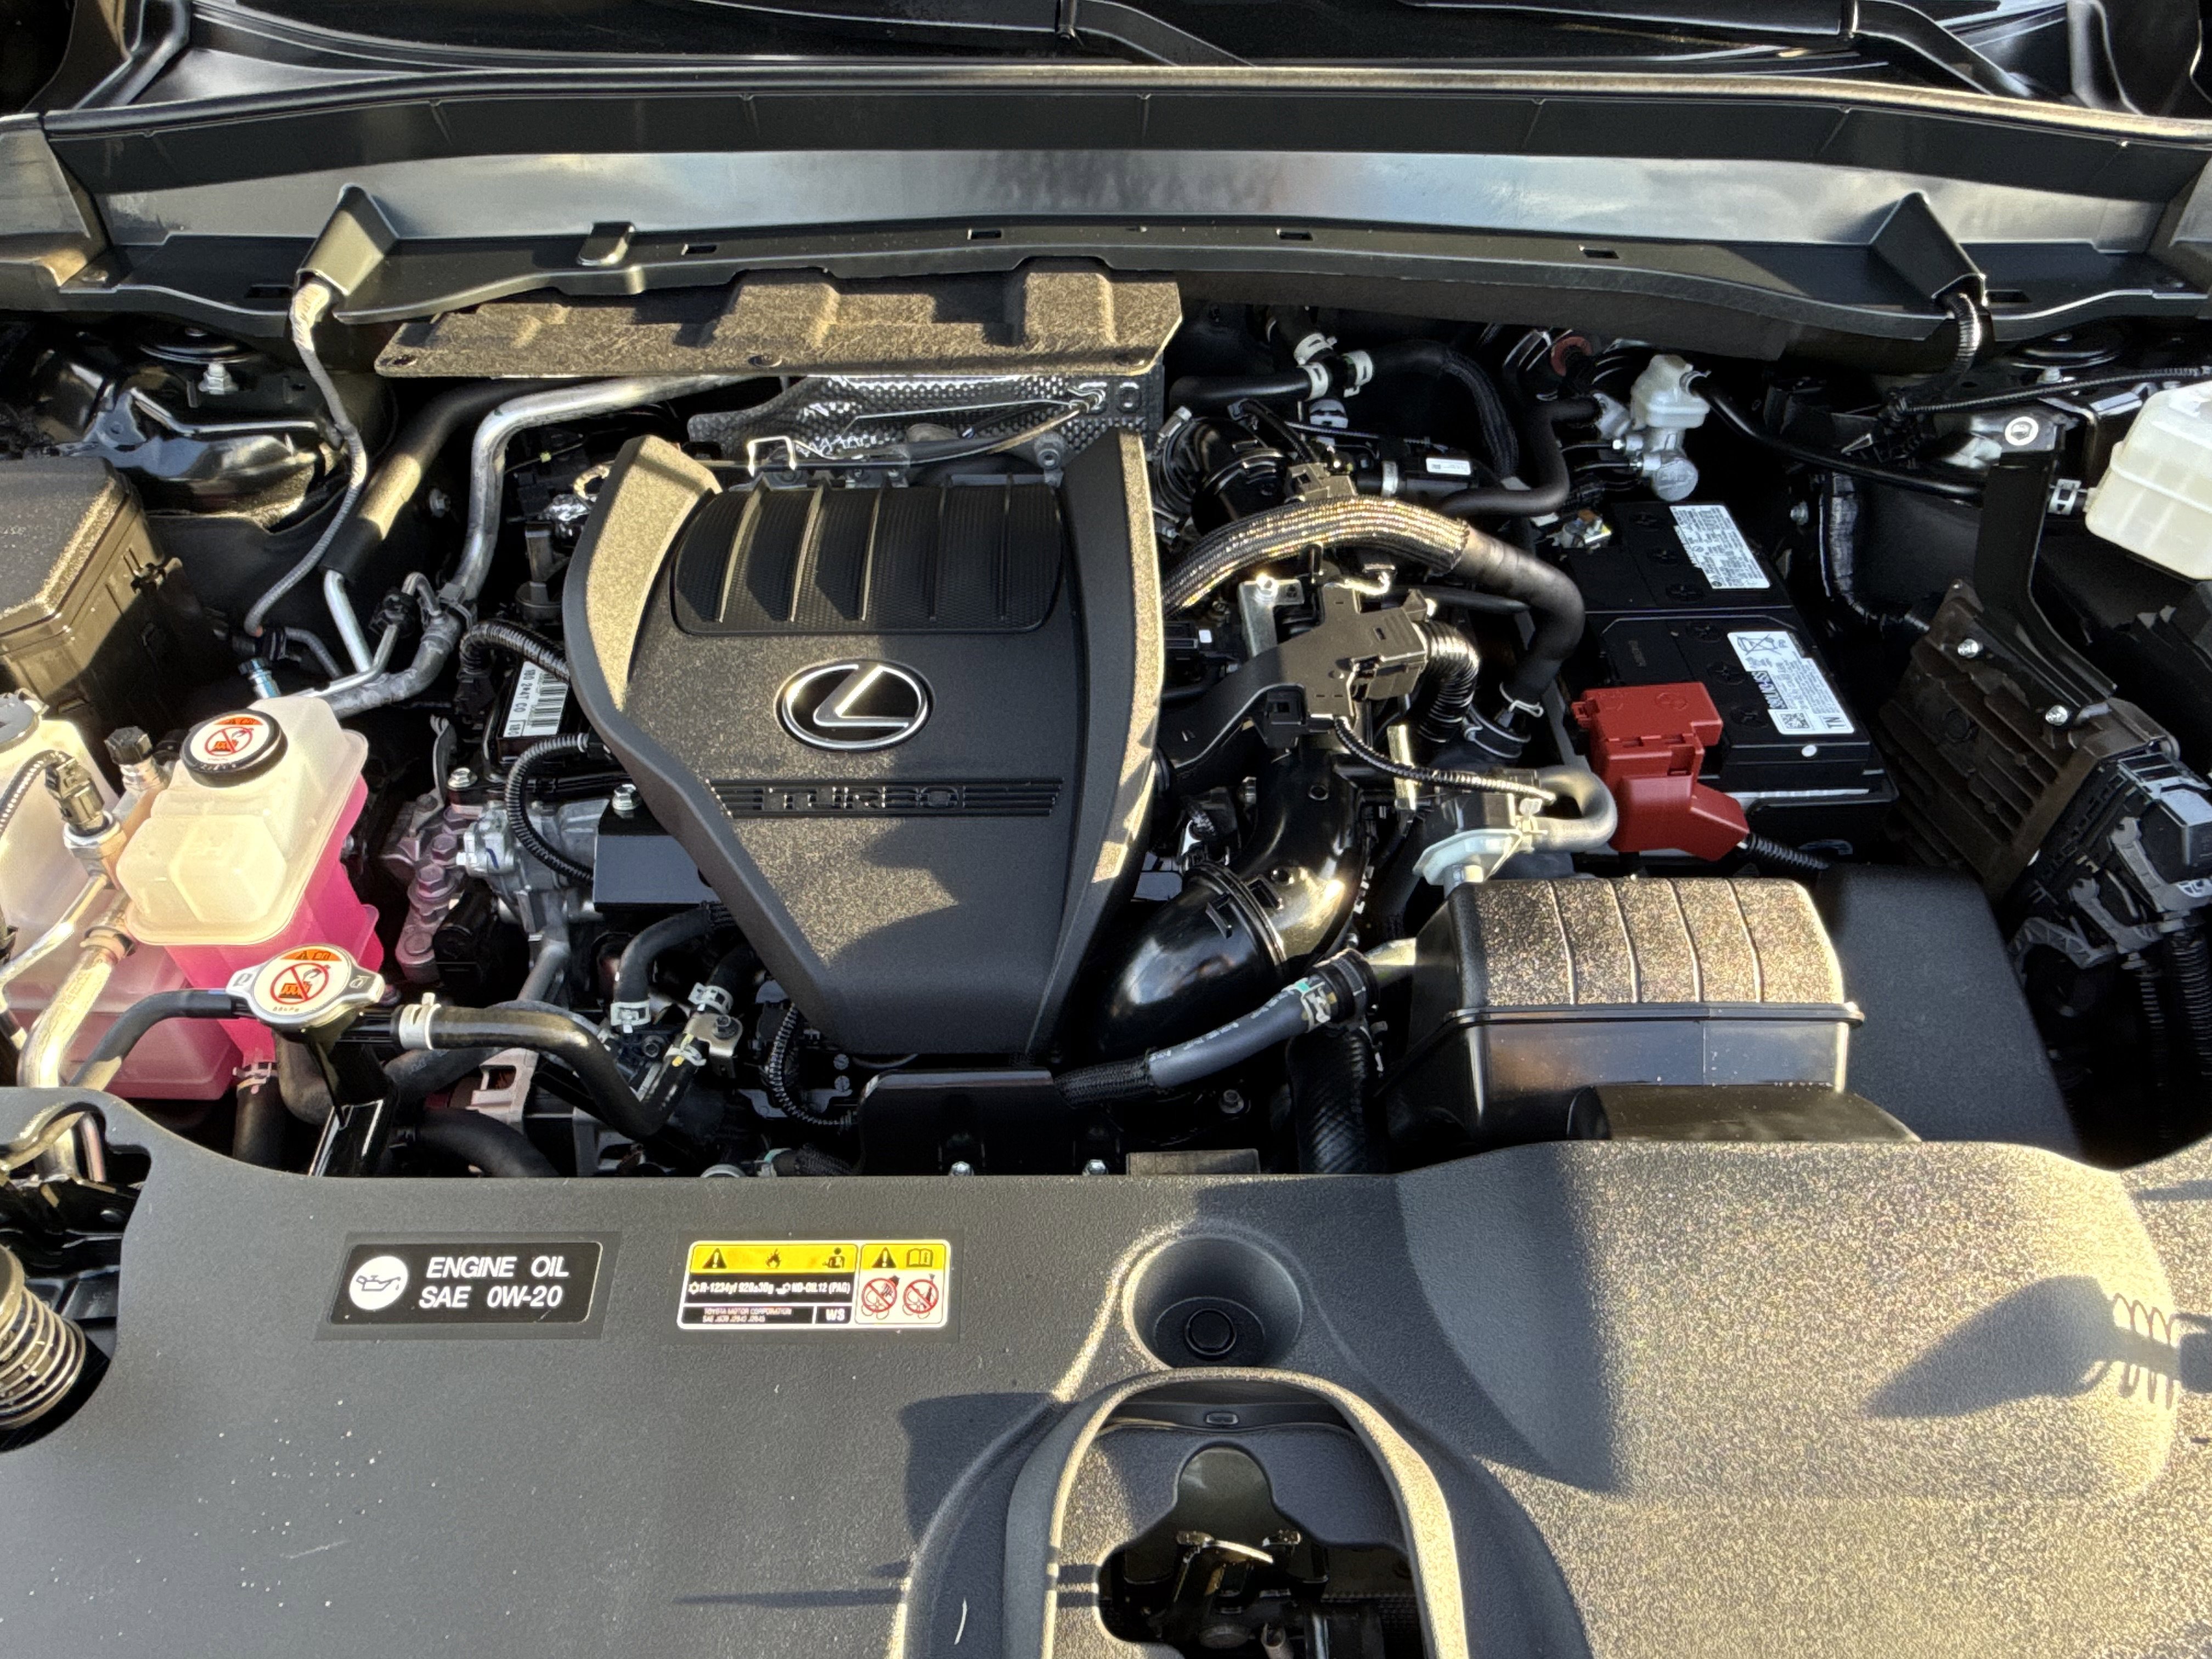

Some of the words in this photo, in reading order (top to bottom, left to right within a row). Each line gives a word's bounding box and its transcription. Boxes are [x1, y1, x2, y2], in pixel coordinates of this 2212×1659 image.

[768, 786, 959, 810] TURBO
[426, 1256, 517, 1278] ENGINE
[531, 1256, 569, 1278] OIL
[419, 1285, 471, 1309] SAE
[486, 1285, 563, 1308] 0W-20
